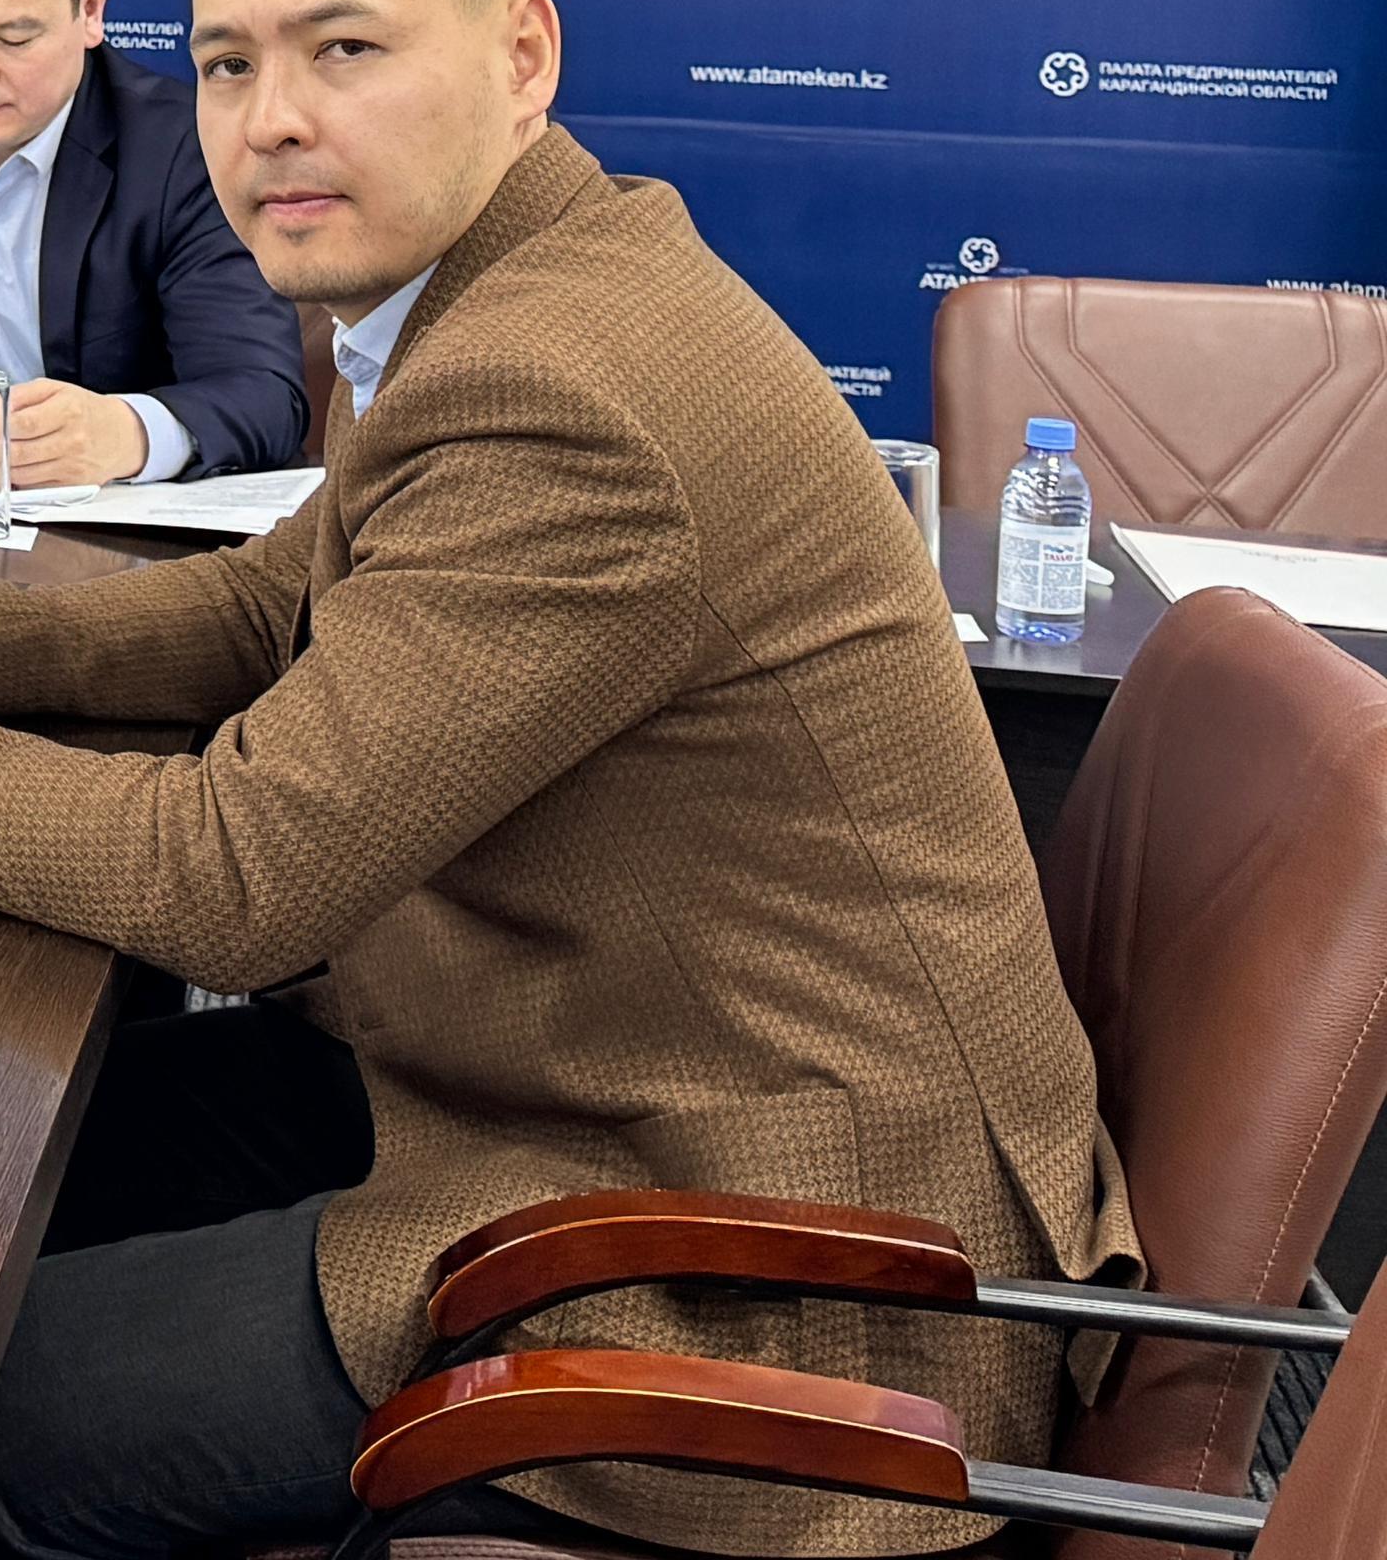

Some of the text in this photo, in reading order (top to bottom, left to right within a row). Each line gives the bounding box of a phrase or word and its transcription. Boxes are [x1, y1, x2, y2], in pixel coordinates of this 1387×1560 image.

[691, 67, 887, 89] www.atameken.kz
[1100, 61, 1163, 78] ПАЛАТА
[1251, 84, 1328, 101] ОБЛАСТИ
